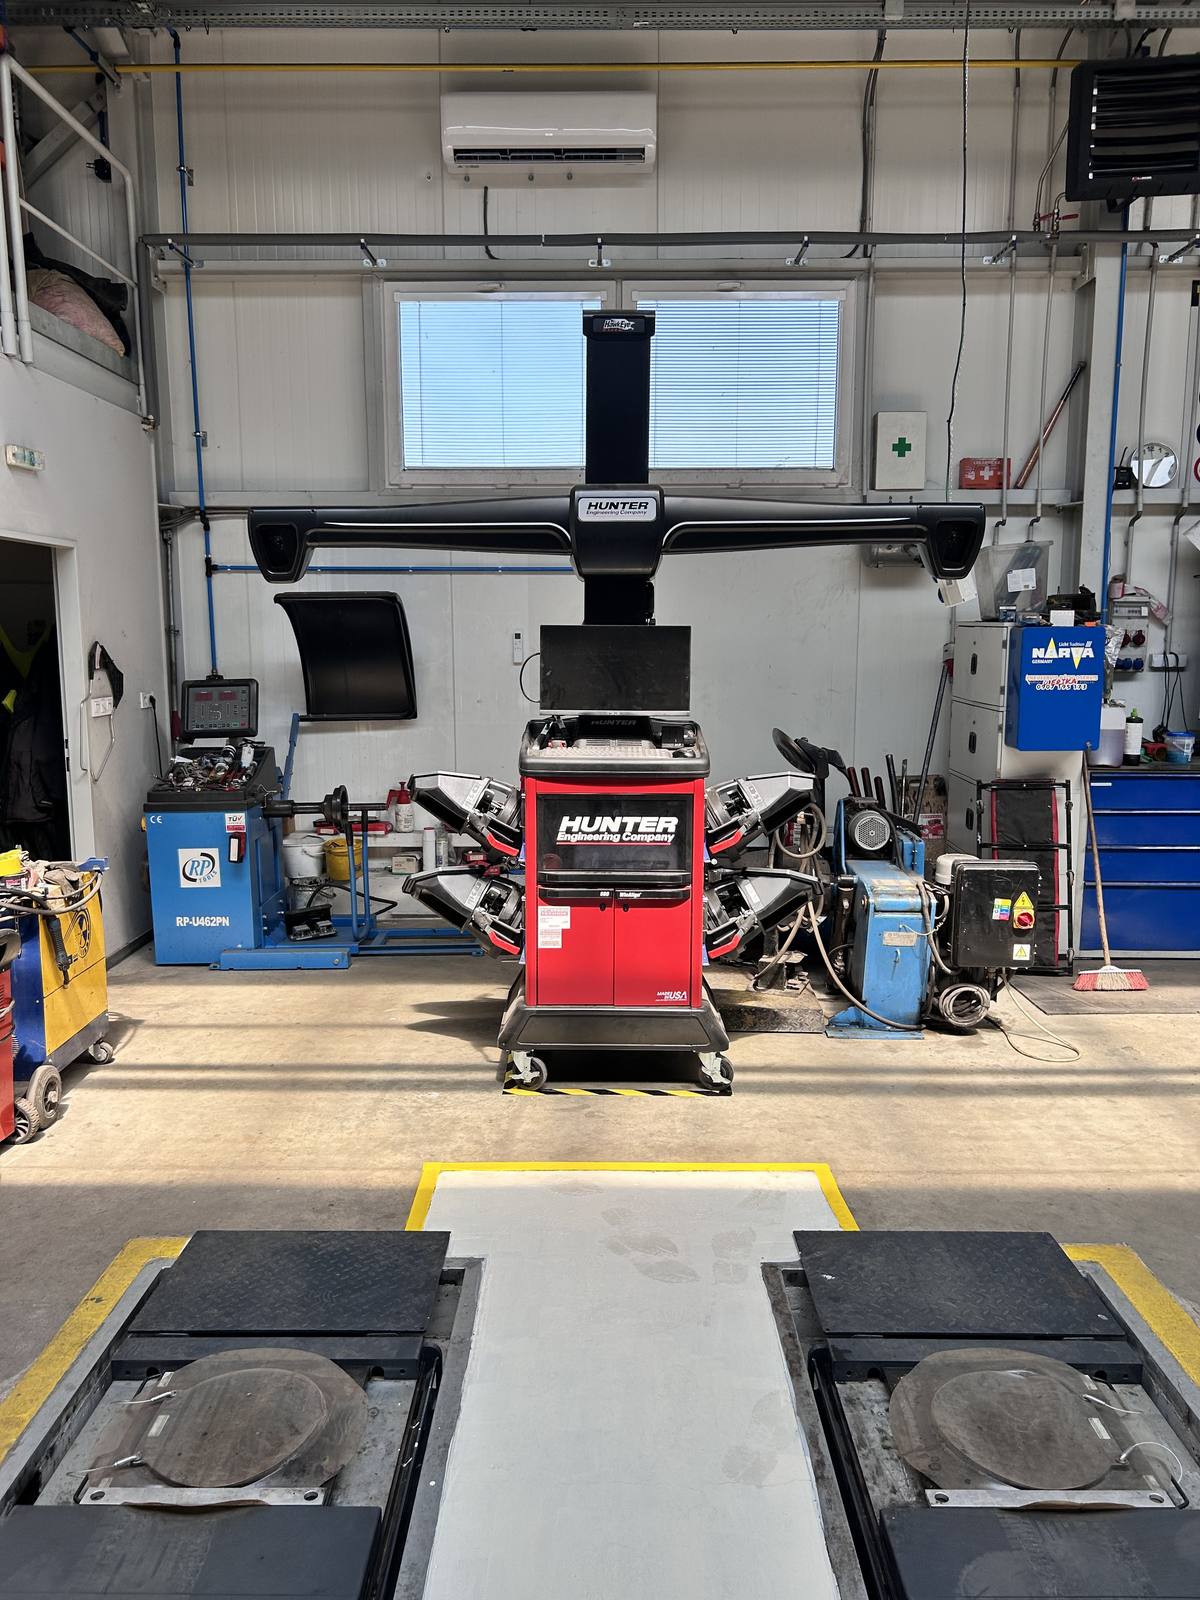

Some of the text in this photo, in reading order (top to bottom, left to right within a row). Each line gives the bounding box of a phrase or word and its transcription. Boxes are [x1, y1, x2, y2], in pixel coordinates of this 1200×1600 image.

[587, 501, 649, 510] HUNTER
[1032, 637, 1095, 670] NARVA
[559, 816, 679, 833] HUNTER
[556, 832, 675, 843] Engineering Company
[188, 859, 211, 876] RP
[198, 870, 218, 883] TOOLS
[176, 916, 230, 927] RP-U462PN
[669, 991, 687, 999] USA
